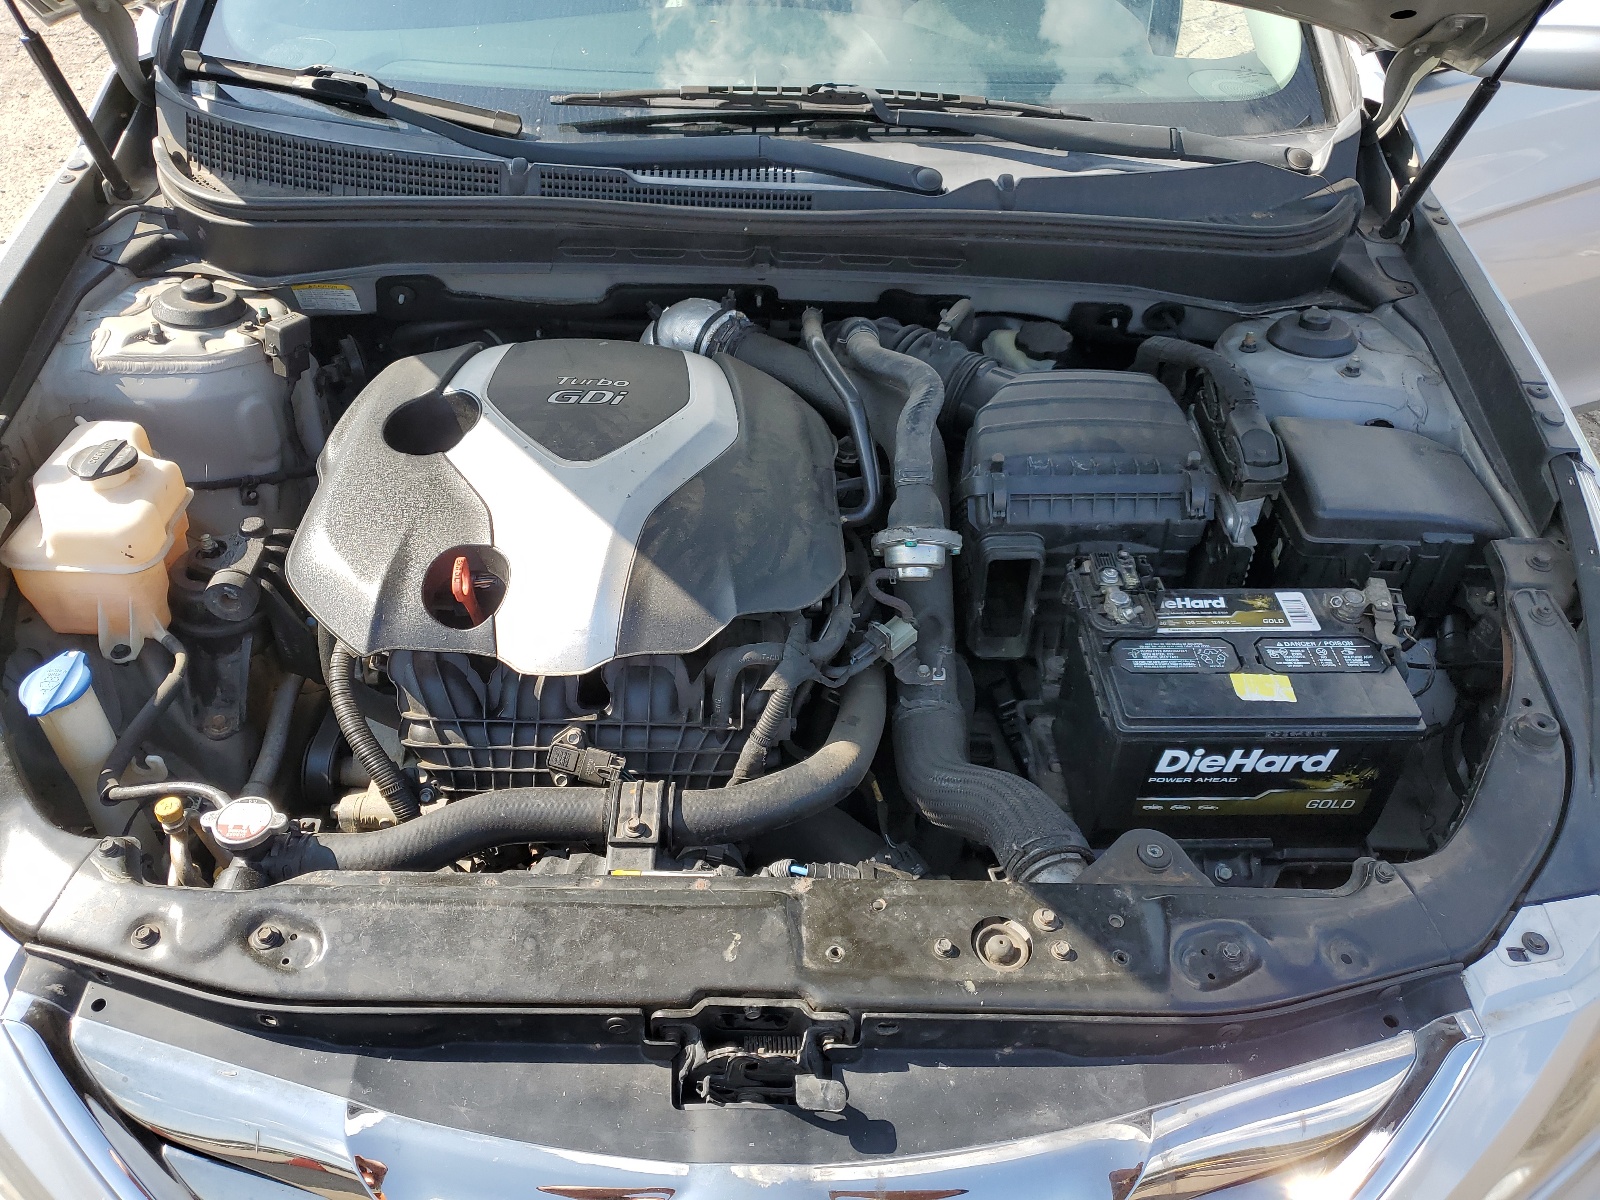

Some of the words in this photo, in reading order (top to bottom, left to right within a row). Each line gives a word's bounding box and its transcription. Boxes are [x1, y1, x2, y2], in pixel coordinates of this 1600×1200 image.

[556, 376, 630, 387] Turbo
[547, 389, 629, 405] GDi
[1154, 748, 1340, 773] DieHard
[1305, 799, 1356, 809] GOLD
